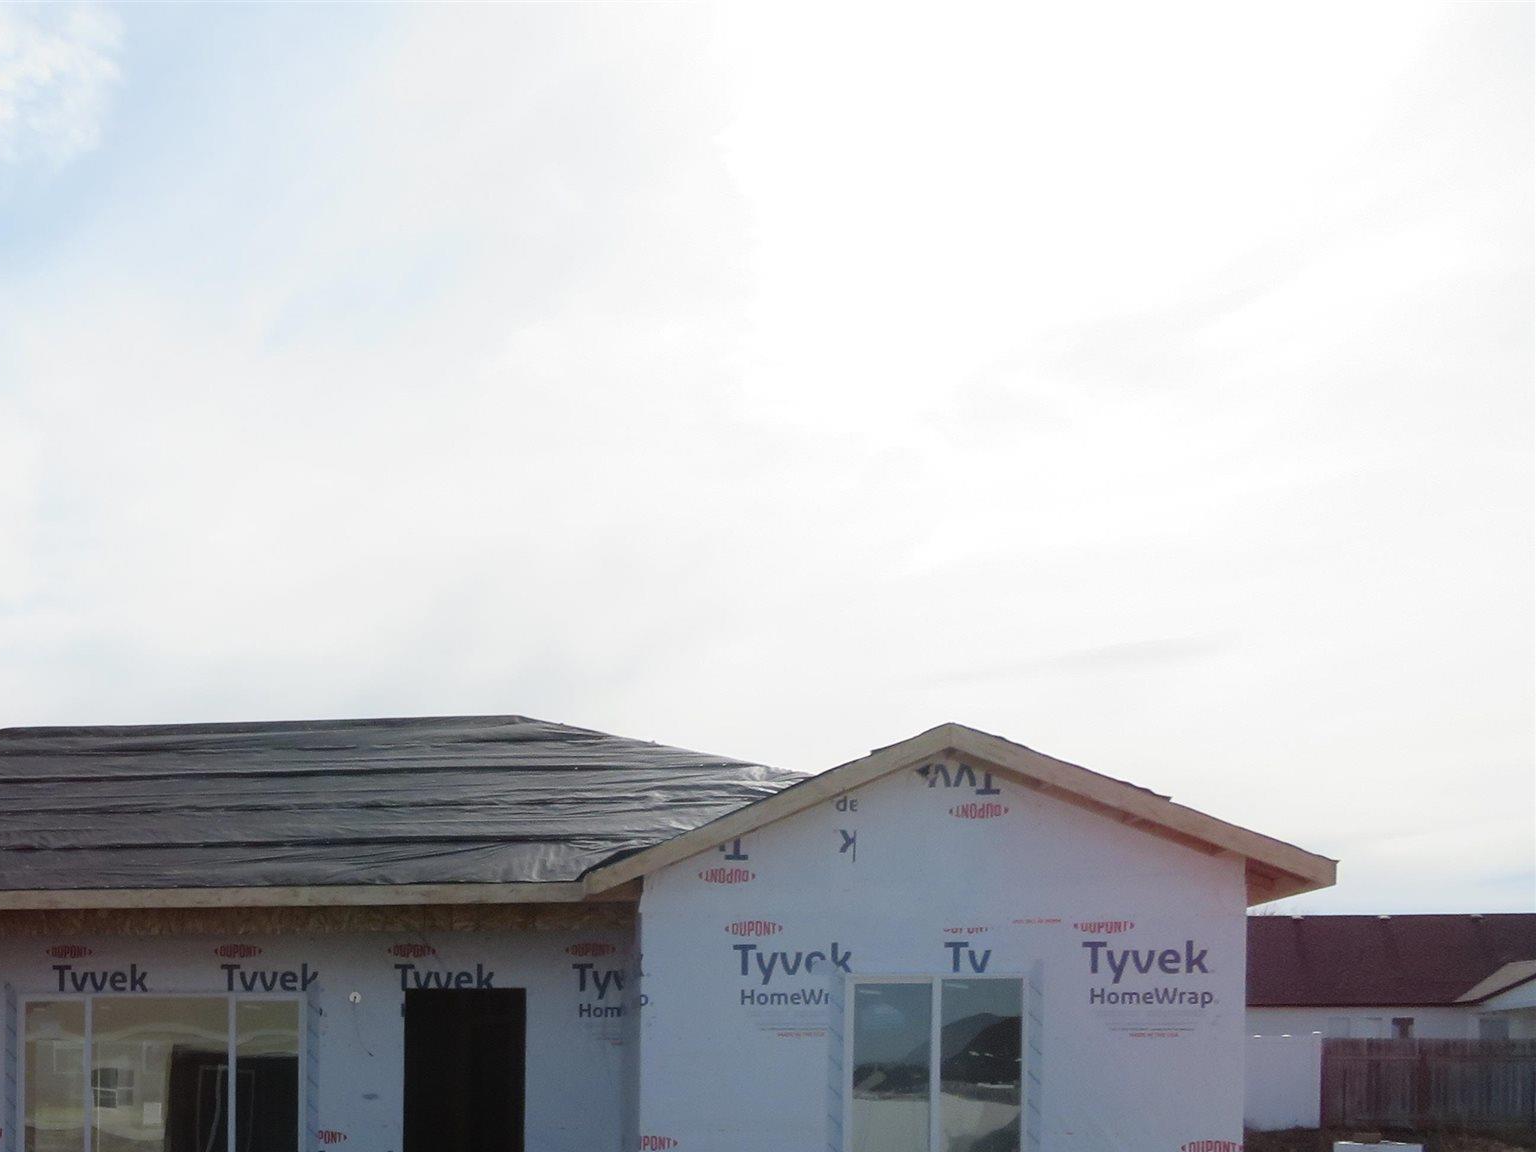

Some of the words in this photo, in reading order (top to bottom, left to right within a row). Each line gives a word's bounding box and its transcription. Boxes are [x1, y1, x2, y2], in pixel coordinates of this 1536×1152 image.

[731, 921, 777, 937] DUPONT
[1082, 940, 1209, 984] Tyvek
[1089, 987, 1214, 1008] HomeWrap
[317, 1130, 342, 1144] PONT
[639, 1135, 672, 1151] PONT
